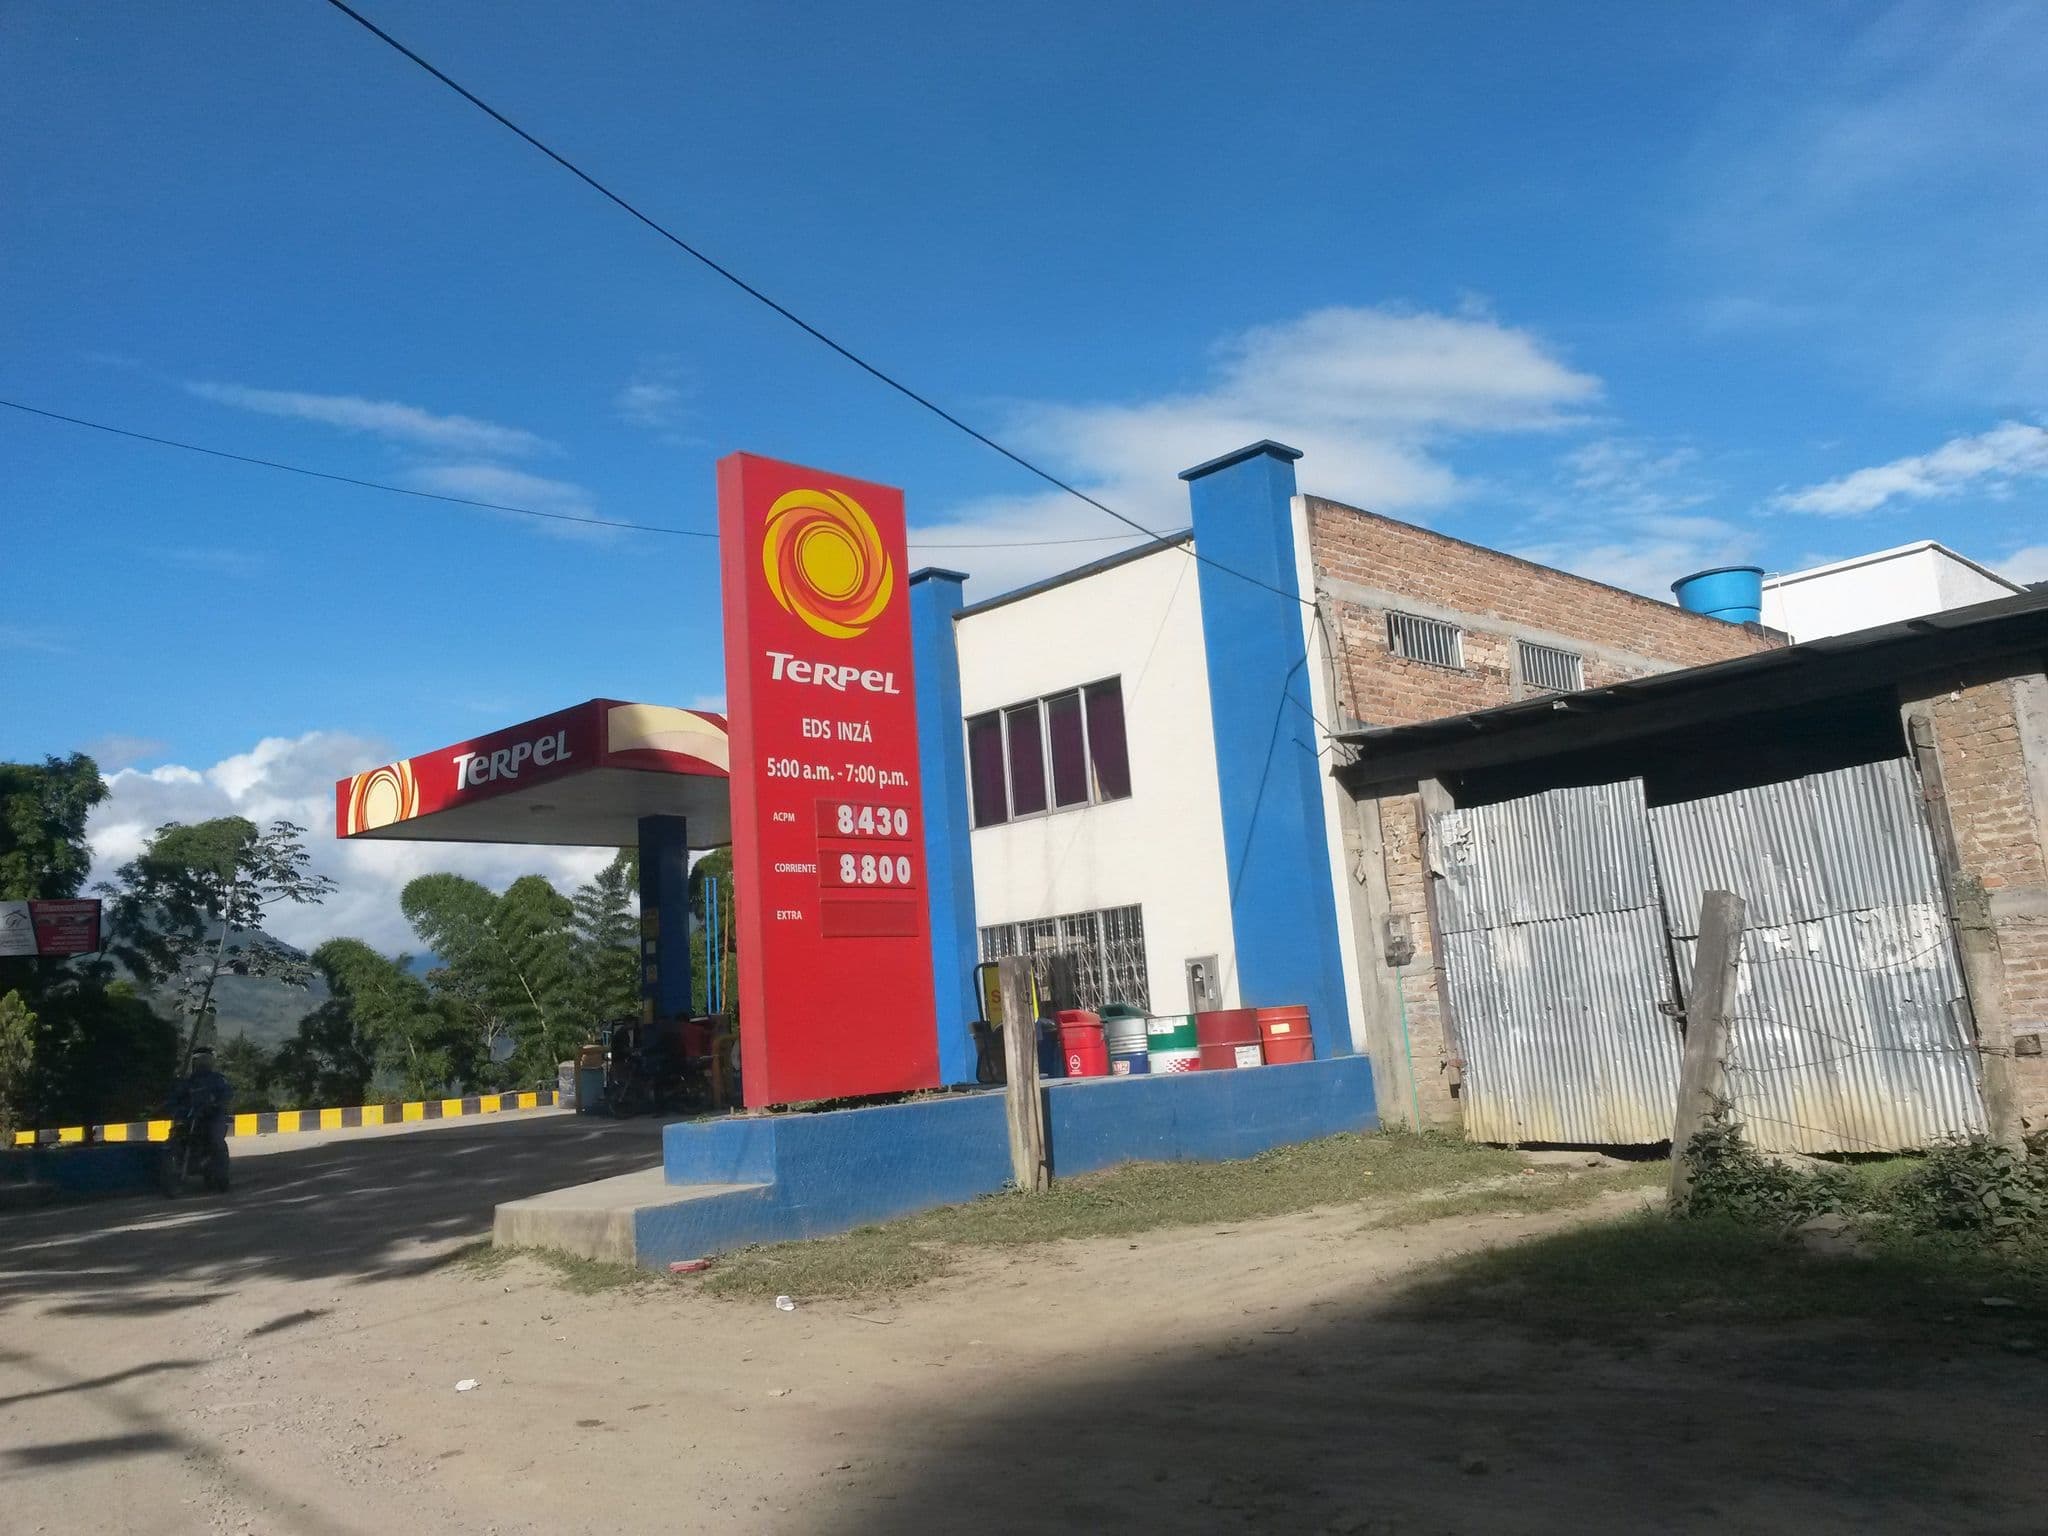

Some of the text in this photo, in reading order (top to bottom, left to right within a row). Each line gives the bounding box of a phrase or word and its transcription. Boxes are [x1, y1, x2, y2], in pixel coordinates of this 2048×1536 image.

[802, 717, 872, 743] EDS INZÁ
[767, 757, 800, 779] 5:00
[803, 764, 835, 781] a.m.
[845, 763, 876, 784] 7:00
[879, 769, 909, 789] p.m.
[773, 811, 795, 822] ACPM
[774, 863, 816, 873] CORRIENTE
[776, 910, 803, 921] EXTRA
